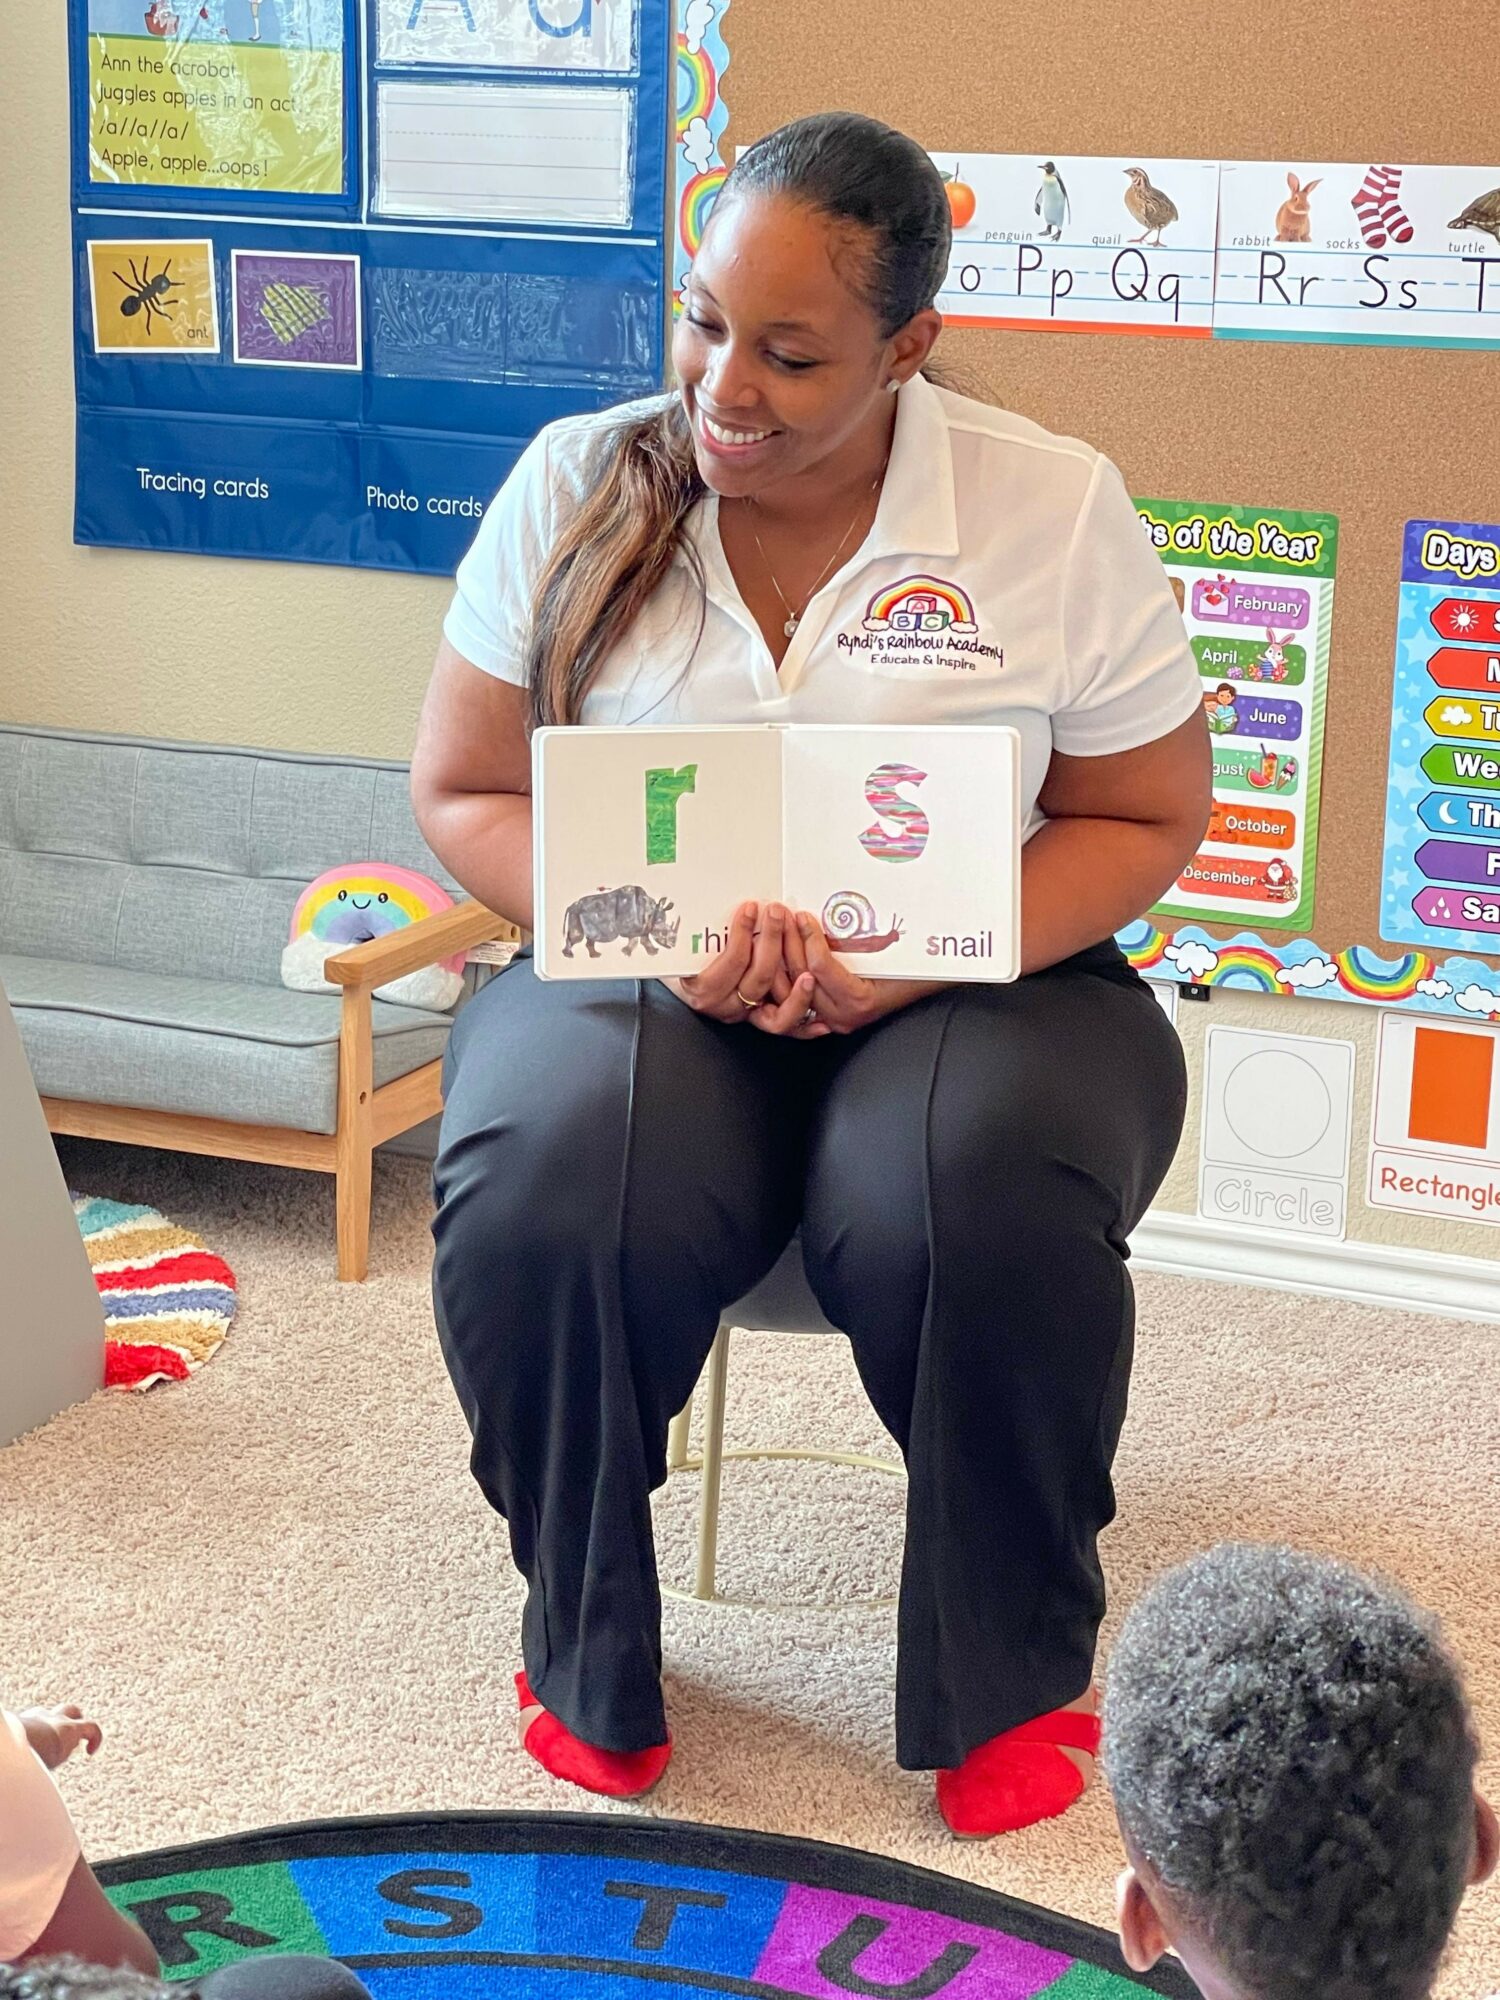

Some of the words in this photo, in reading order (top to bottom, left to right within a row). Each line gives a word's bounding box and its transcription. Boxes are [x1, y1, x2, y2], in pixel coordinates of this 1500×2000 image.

[101, 54, 131, 72] Ann
[138, 56, 164, 74] the
[170, 60, 236, 78] acrobat
[98, 84, 156, 105] juggles
[163, 89, 217, 109] apples
[224, 92, 237, 107] in
[243, 97, 264, 111] an
[101, 148, 154, 171] Apple,
[985, 230, 1033, 243] penguin
[1092, 234, 1121, 246] quail
[1232, 235, 1271, 248] rabbit
[1326, 237, 1360, 251] socks
[1448, 242, 1486, 255] turtle
[1017, 244, 1073, 317] Pp
[1112, 247, 1180, 323] Qq
[1258, 250, 1320, 306] Rr
[1359, 254, 1418, 310] Ss
[187, 327, 209, 339] ant
[136, 468, 206, 500] Tracing
[213, 478, 269, 499] cards
[366, 486, 419, 512] Photo
[427, 496, 483, 517] cards
[1173, 518, 1205, 549] of
[1208, 520, 1255, 555] the
[1257, 522, 1319, 562] Year
[1426, 533, 1496, 575] Days
[1234, 595, 1303, 618] February
[837, 632, 885, 656] Ryndi's
[887, 632, 943, 650] Rainbow
[946, 636, 1004, 668] Academy
[871, 653, 920, 666] Educate
[923, 655, 933, 665] &
[936, 654, 976, 672] Inspire
[1201, 647, 1238, 666] April
[1249, 707, 1287, 725] June
[645, 763, 698, 866] r
[1225, 815, 1287, 836] October
[1183, 864, 1257, 887] December
[926, 931, 993, 958] snail
[1215, 1178, 1335, 1226] Circle
[128, 1890, 284, 1967] R
[376, 1868, 484, 1939] S
[604, 1880, 728, 1951] T
[817, 1914, 982, 2000] U
